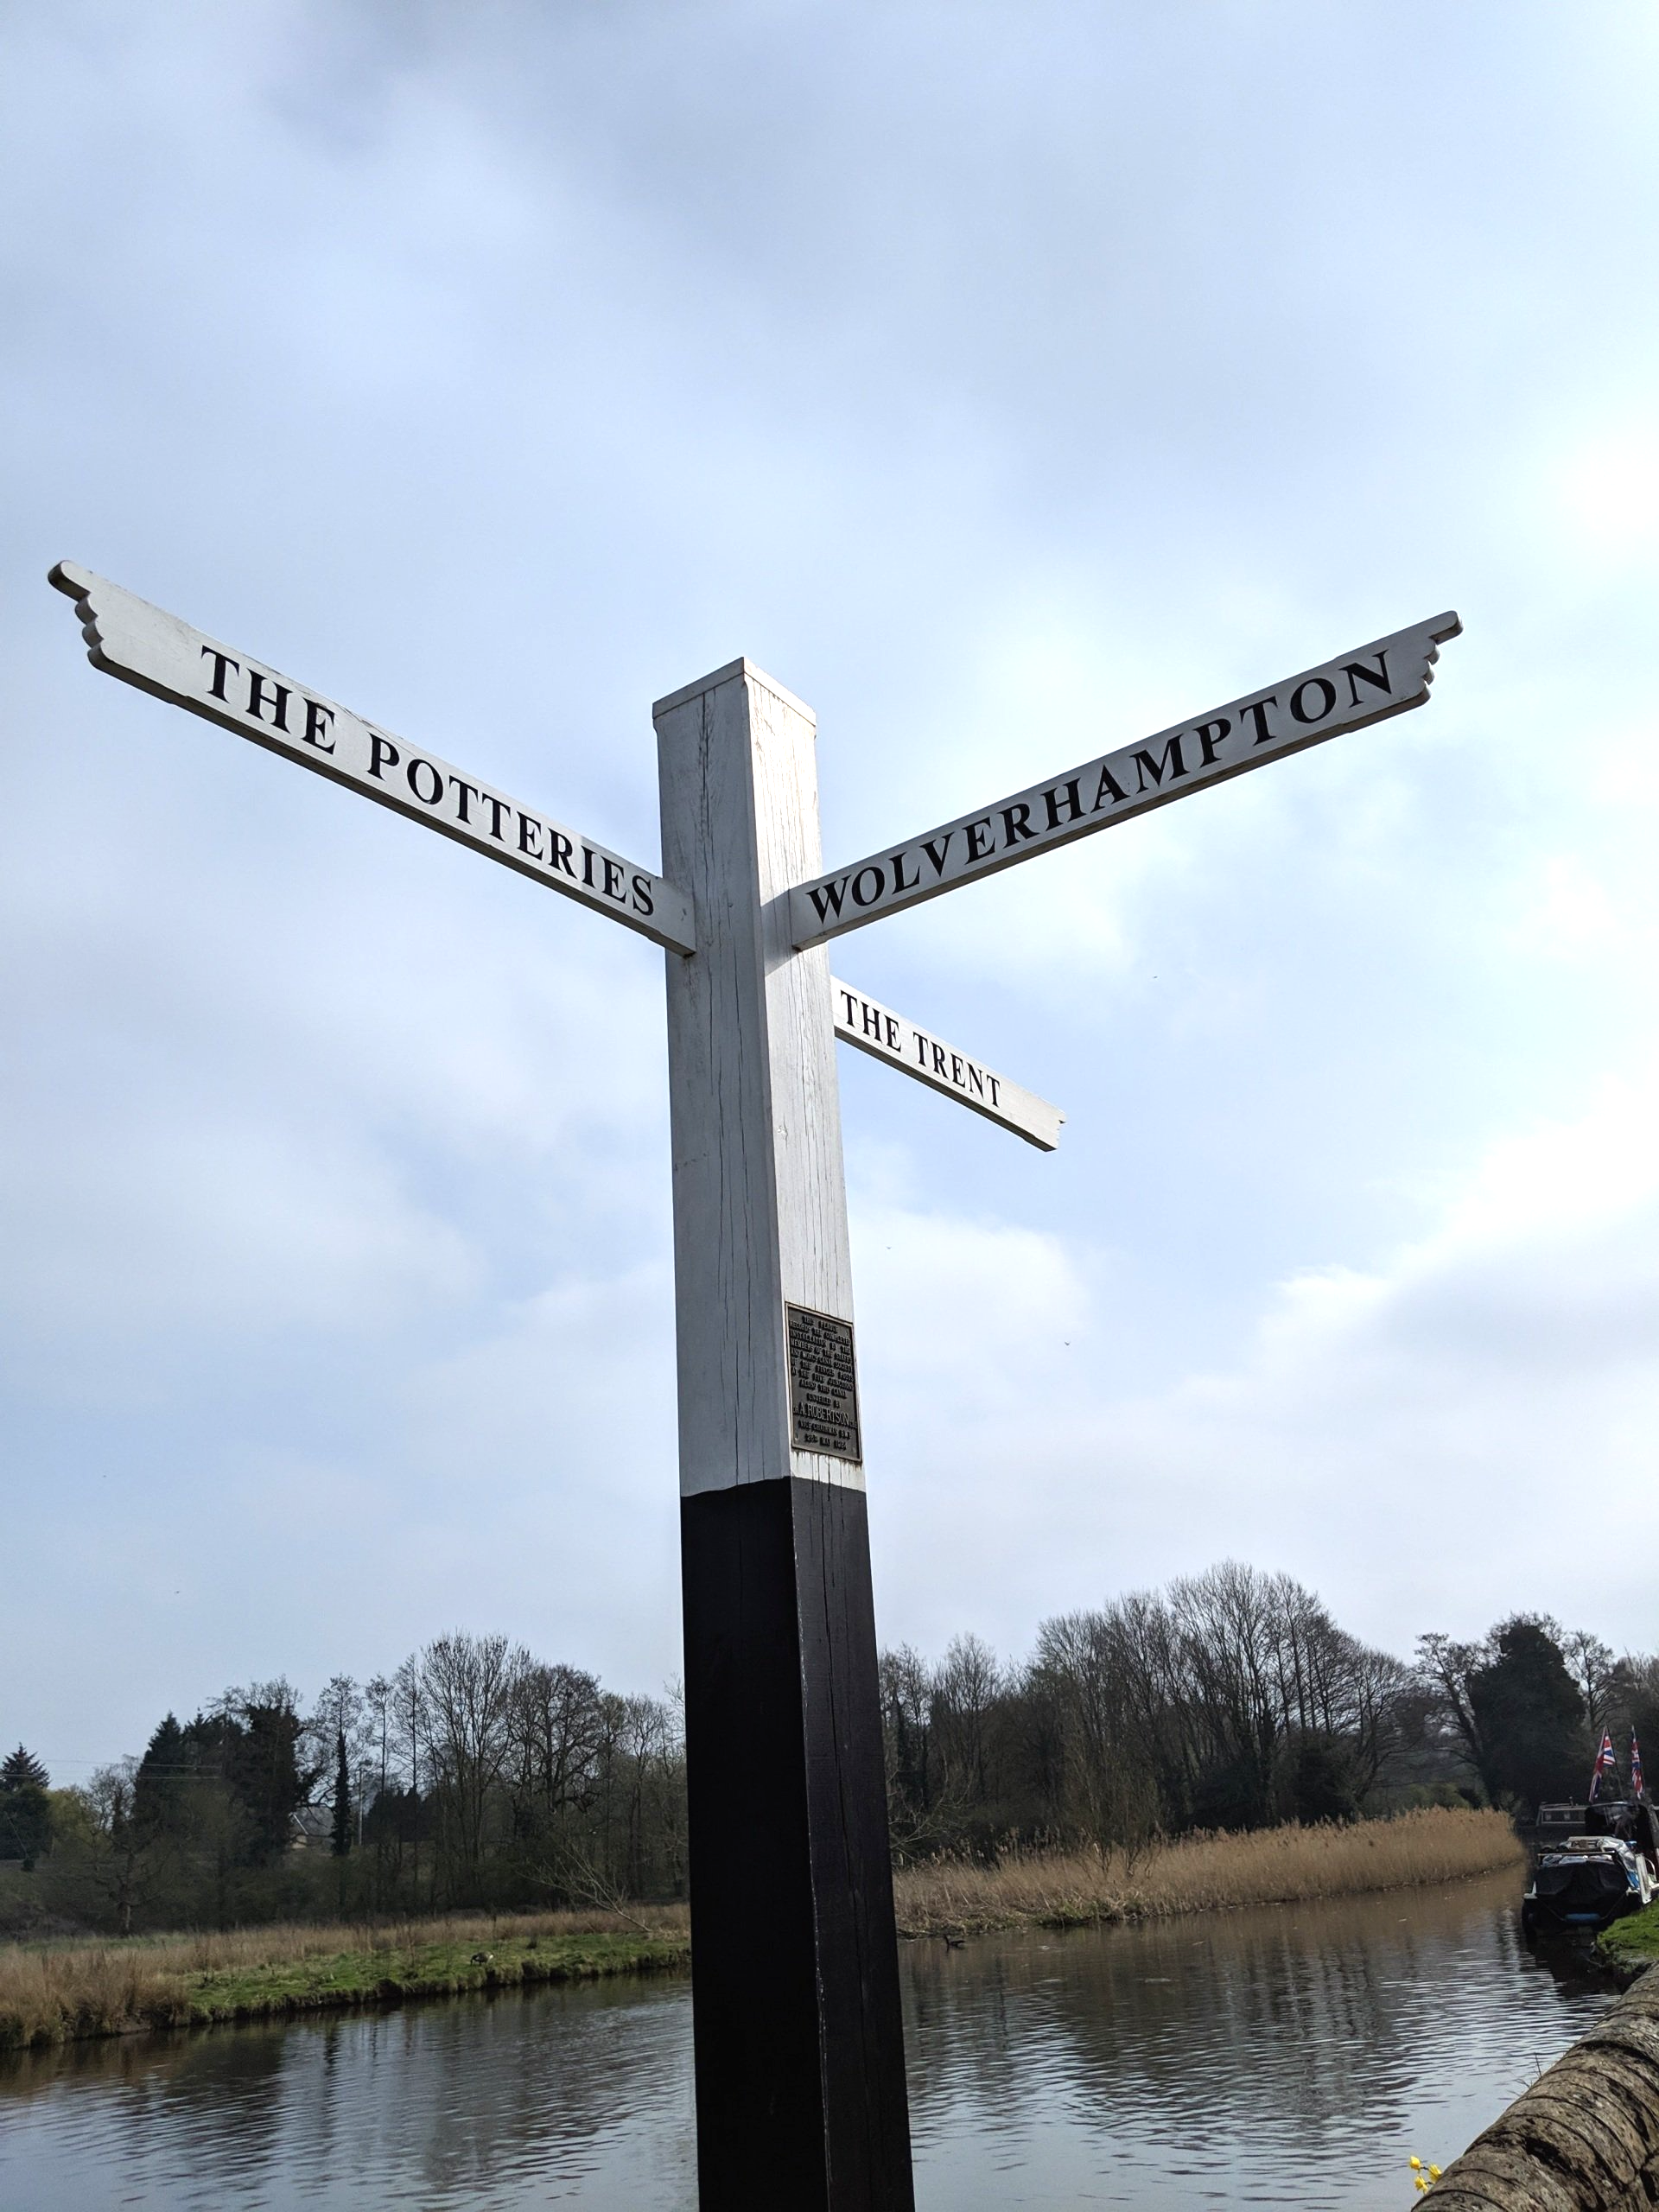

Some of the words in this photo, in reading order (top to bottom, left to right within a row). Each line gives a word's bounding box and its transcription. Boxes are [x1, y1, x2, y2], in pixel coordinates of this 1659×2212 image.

[201, 645, 337, 754] THE
[366, 733, 655, 916] POTTERIES
[805, 649, 1392, 924] WOLVERHAMPTON
[840, 989, 901, 1052] THE
[912, 1031, 1001, 1108] TRENT
